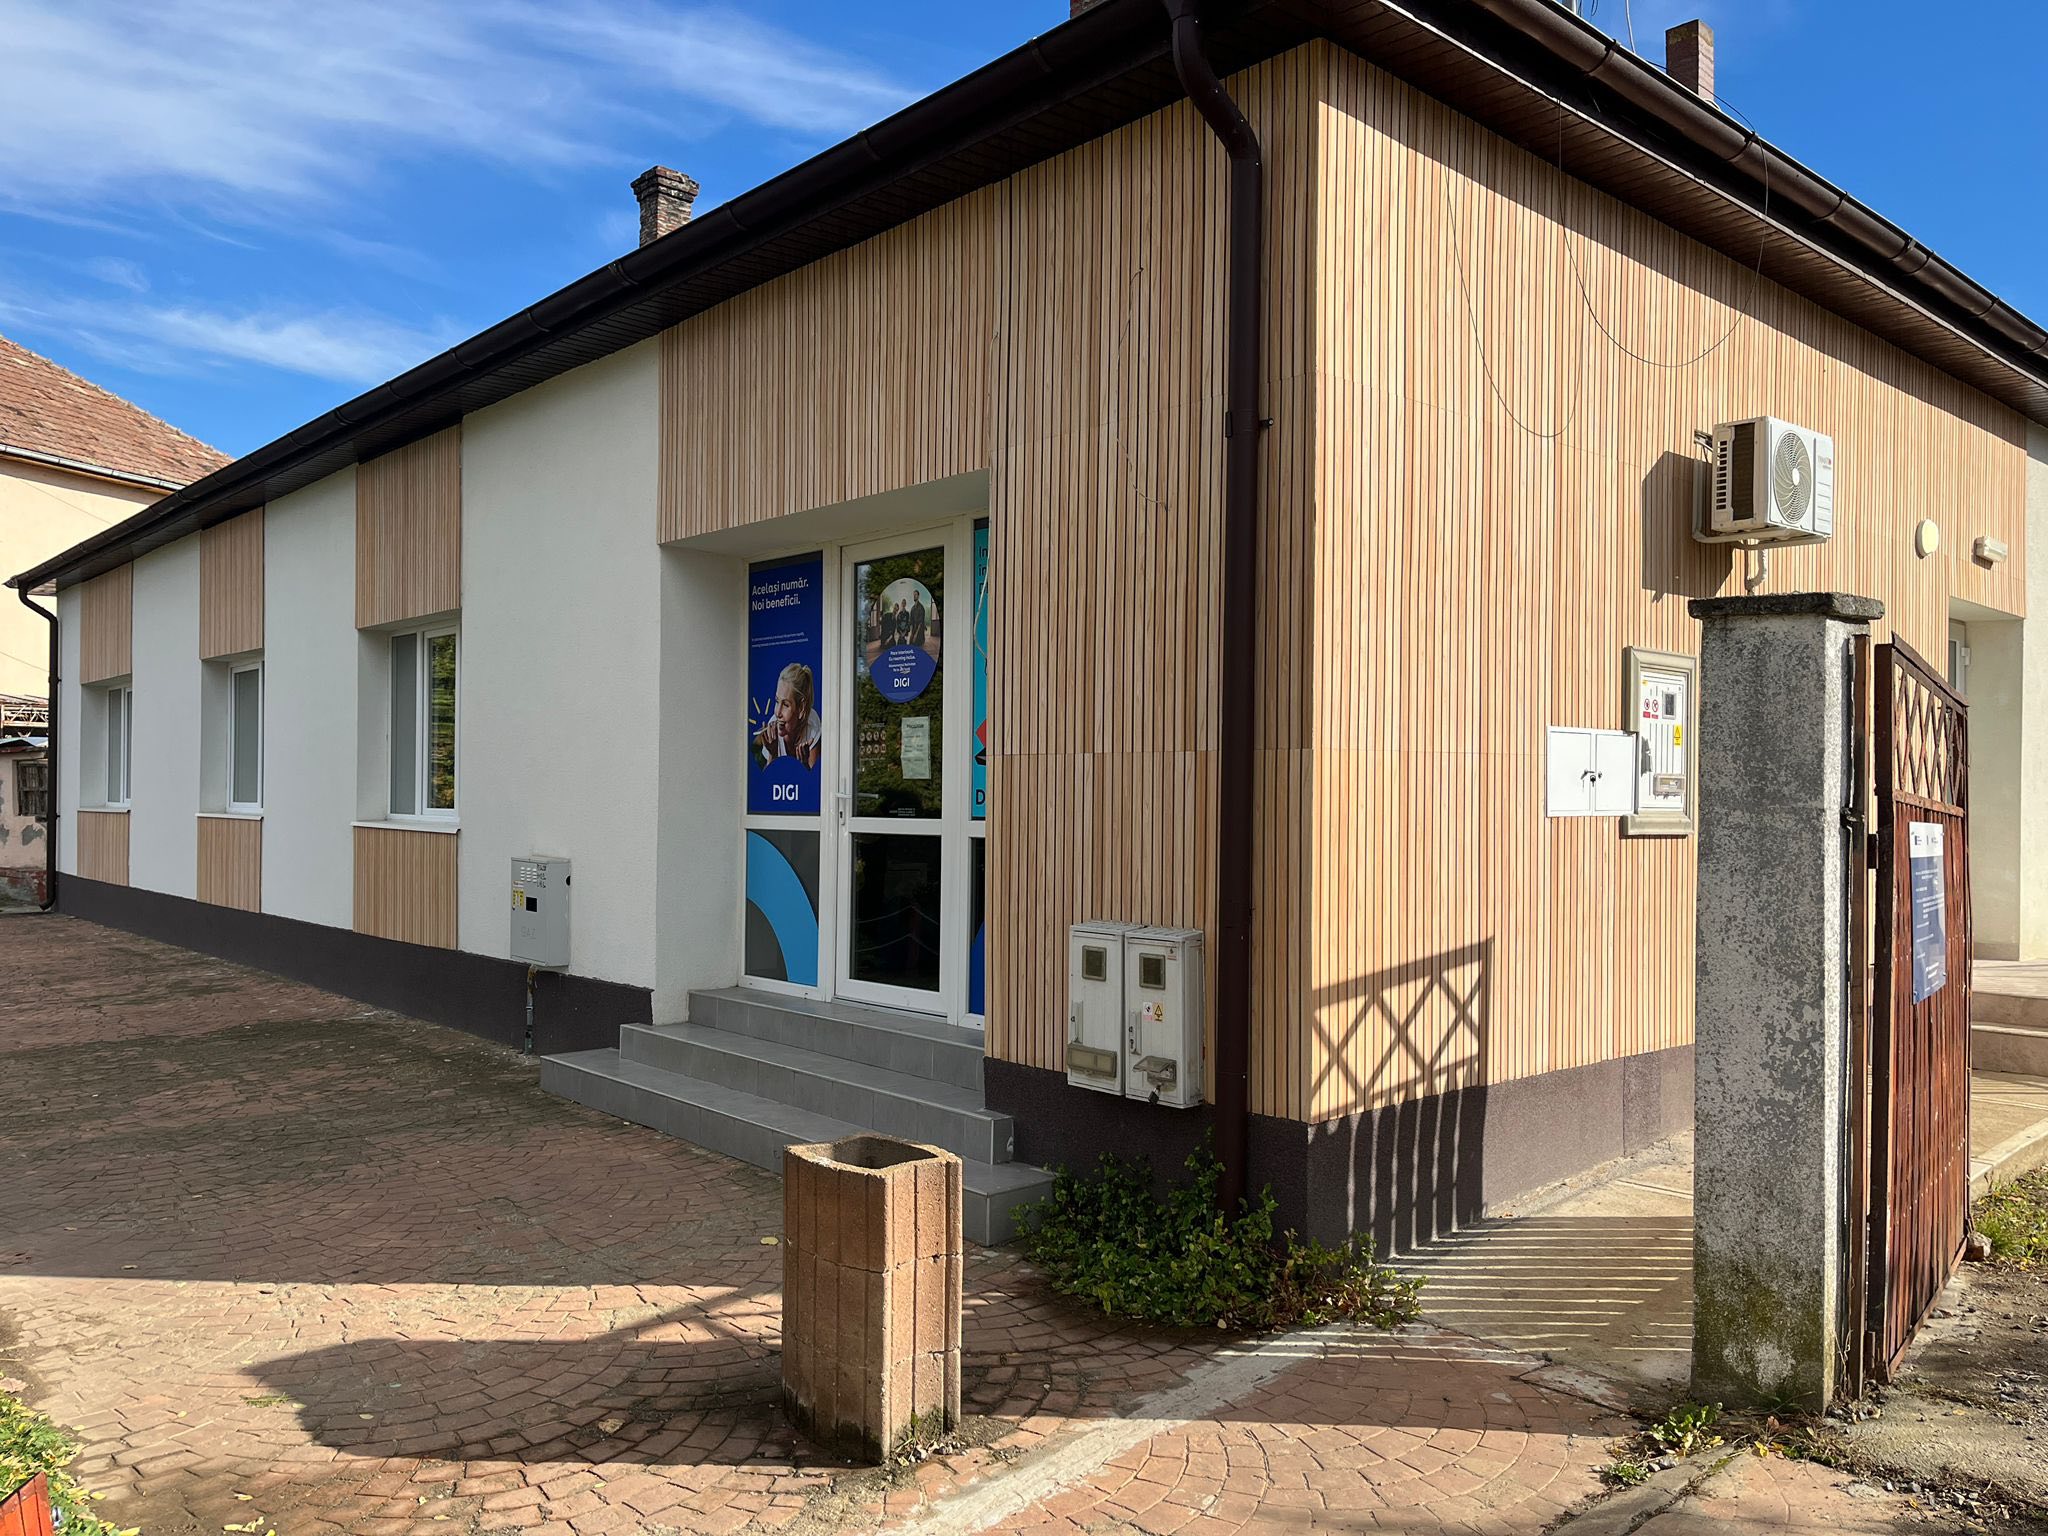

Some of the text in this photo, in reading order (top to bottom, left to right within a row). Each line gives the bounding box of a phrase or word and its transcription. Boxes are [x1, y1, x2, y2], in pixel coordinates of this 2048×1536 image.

[752, 577, 809, 596] Același număr.
[752, 593, 801, 611] Noi beneficii.
[894, 677, 910, 688] DIGI
[772, 784, 799, 801] DIGI
